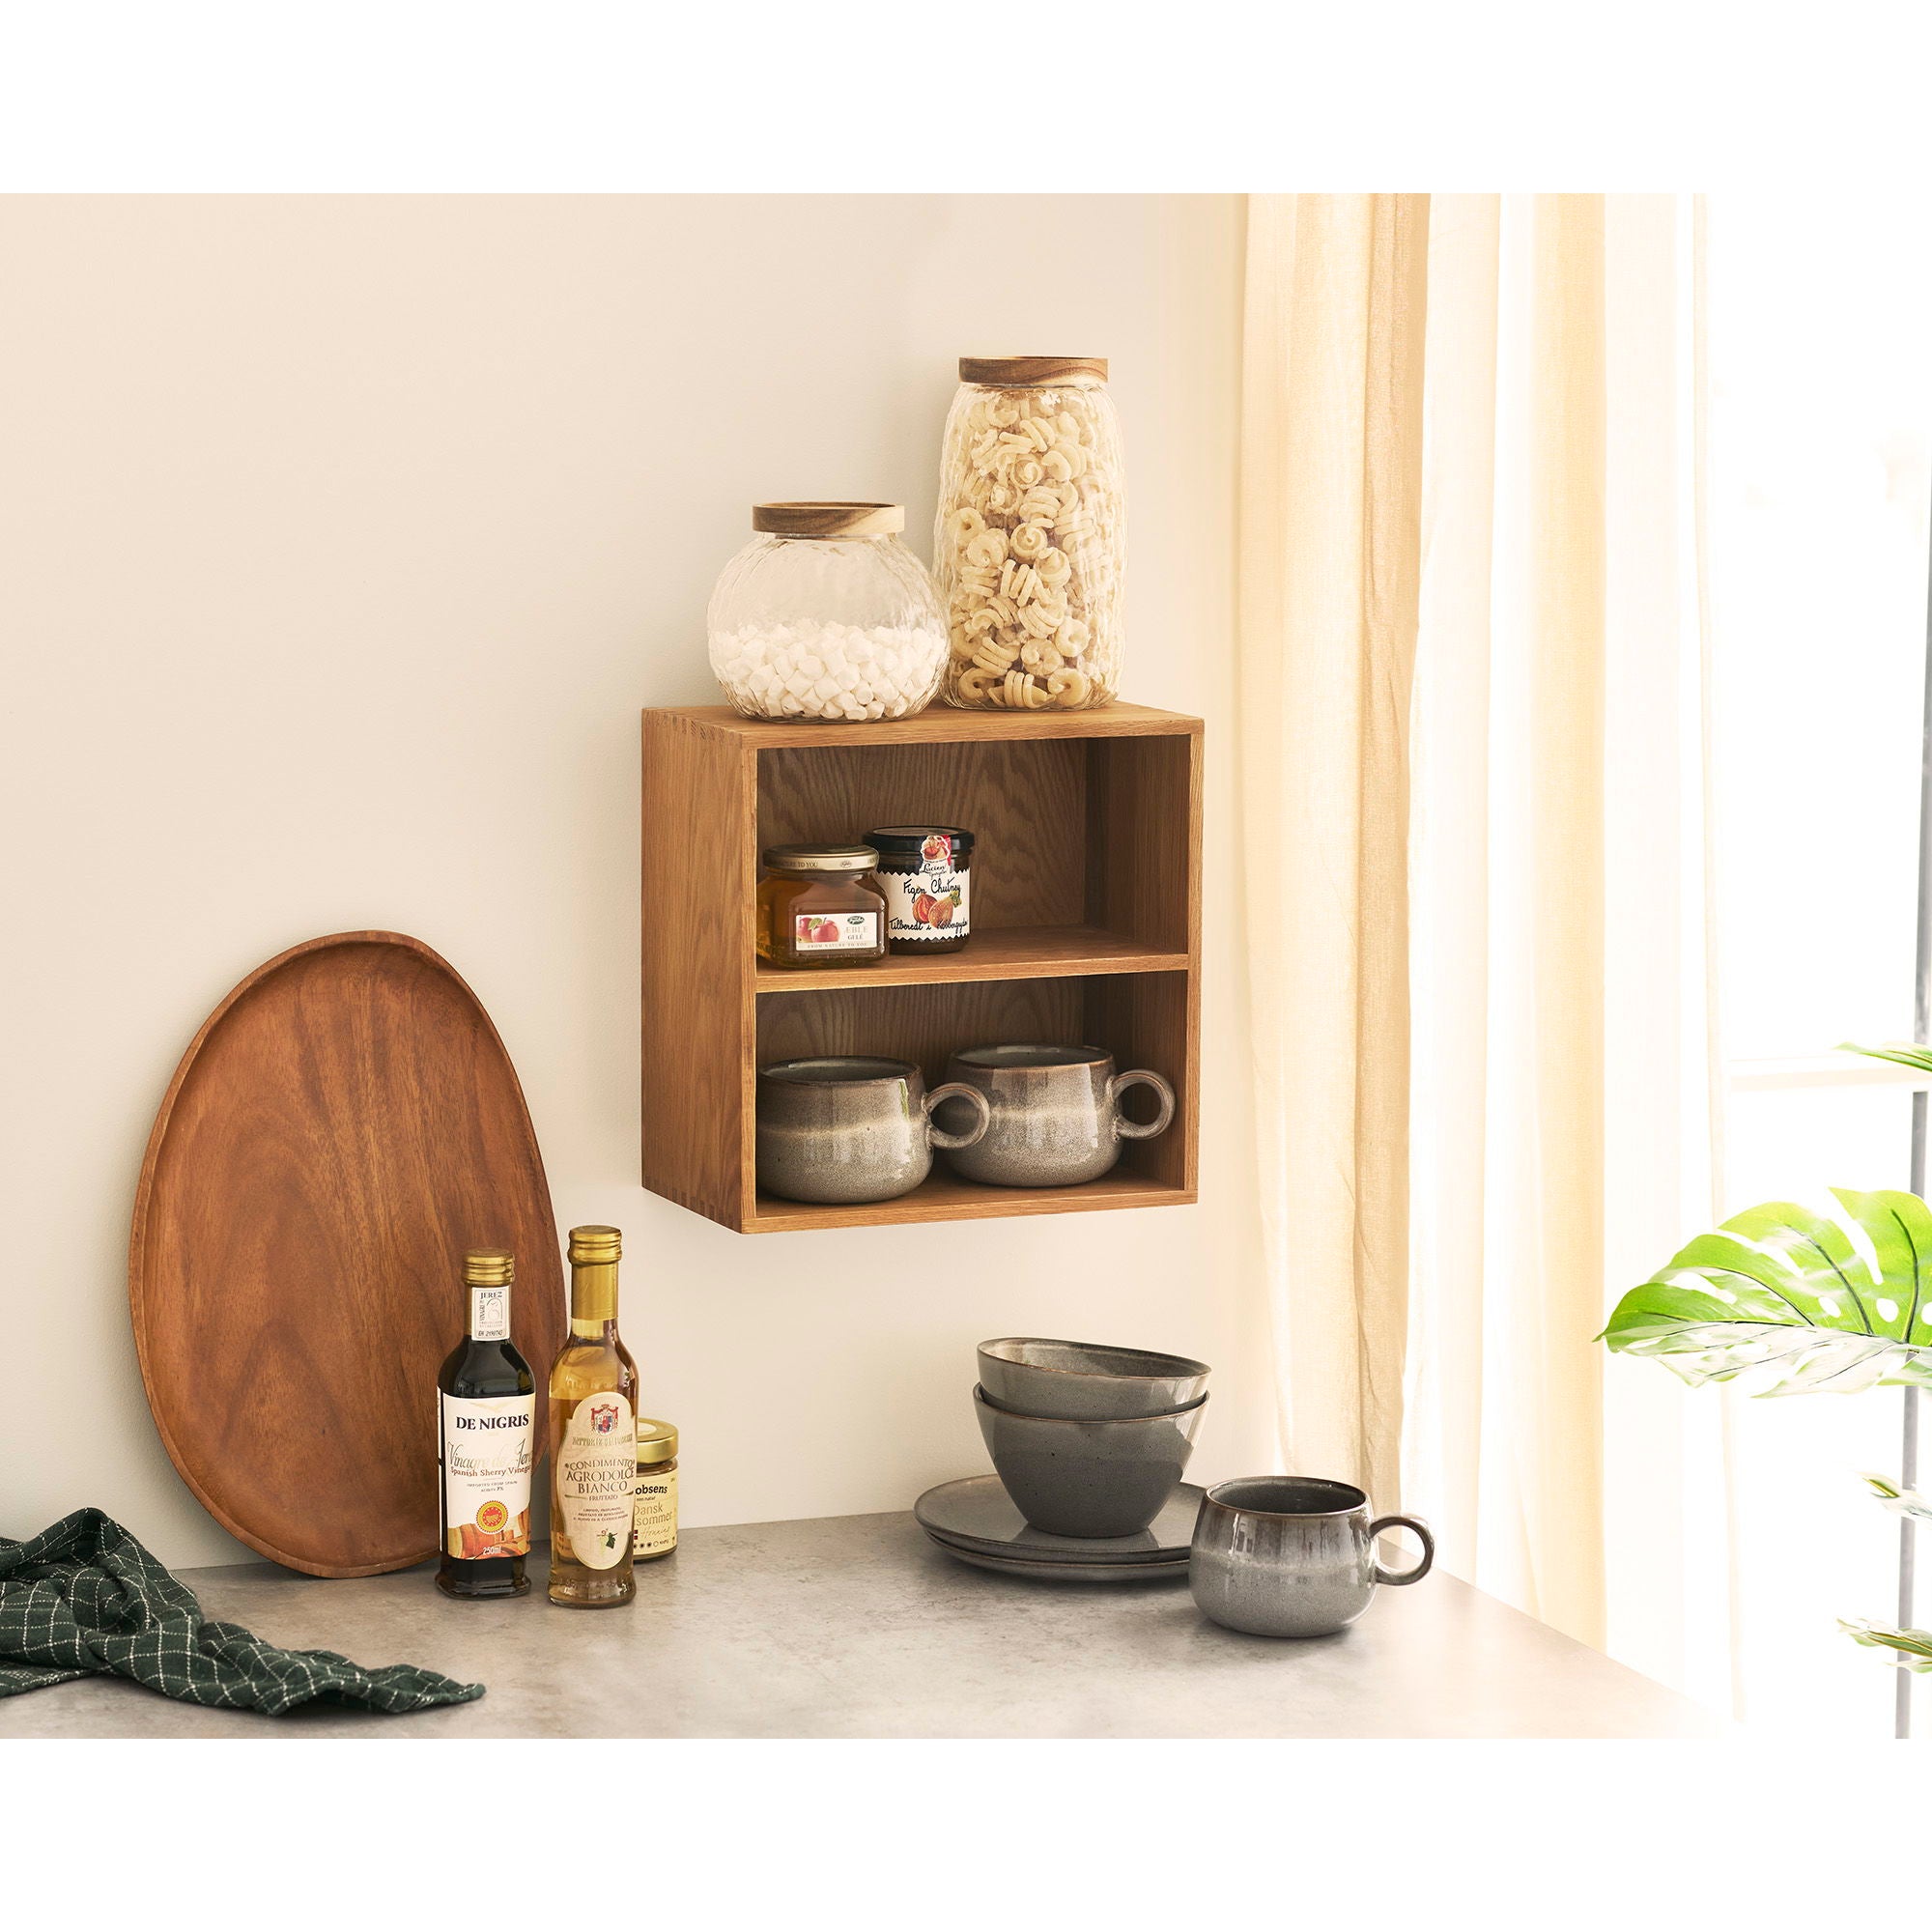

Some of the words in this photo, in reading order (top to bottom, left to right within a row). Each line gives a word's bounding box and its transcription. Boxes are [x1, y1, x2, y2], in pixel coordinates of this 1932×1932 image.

[903, 878, 927, 903] Figen
[930, 876, 961, 899] Chutney
[889, 917, 923, 930] Tilberedt
[480, 1291, 502, 1299] JEREZ
[456, 1416, 476, 1430] DE
[479, 1413, 529, 1430] NIGRIS
[450, 1465, 478, 1477] Spanish
[480, 1467, 506, 1477] Sherry
[569, 1459, 634, 1471] CONDIMENTO
[566, 1467, 634, 1482] AGRODOLCE
[578, 1481, 628, 1493] BIANCO
[636, 1484, 668, 1495] obsens
[634, 1501, 663, 1516] Dansk
[637, 1511, 672, 1526] sommer
[483, 1546, 501, 1555] 250ml
